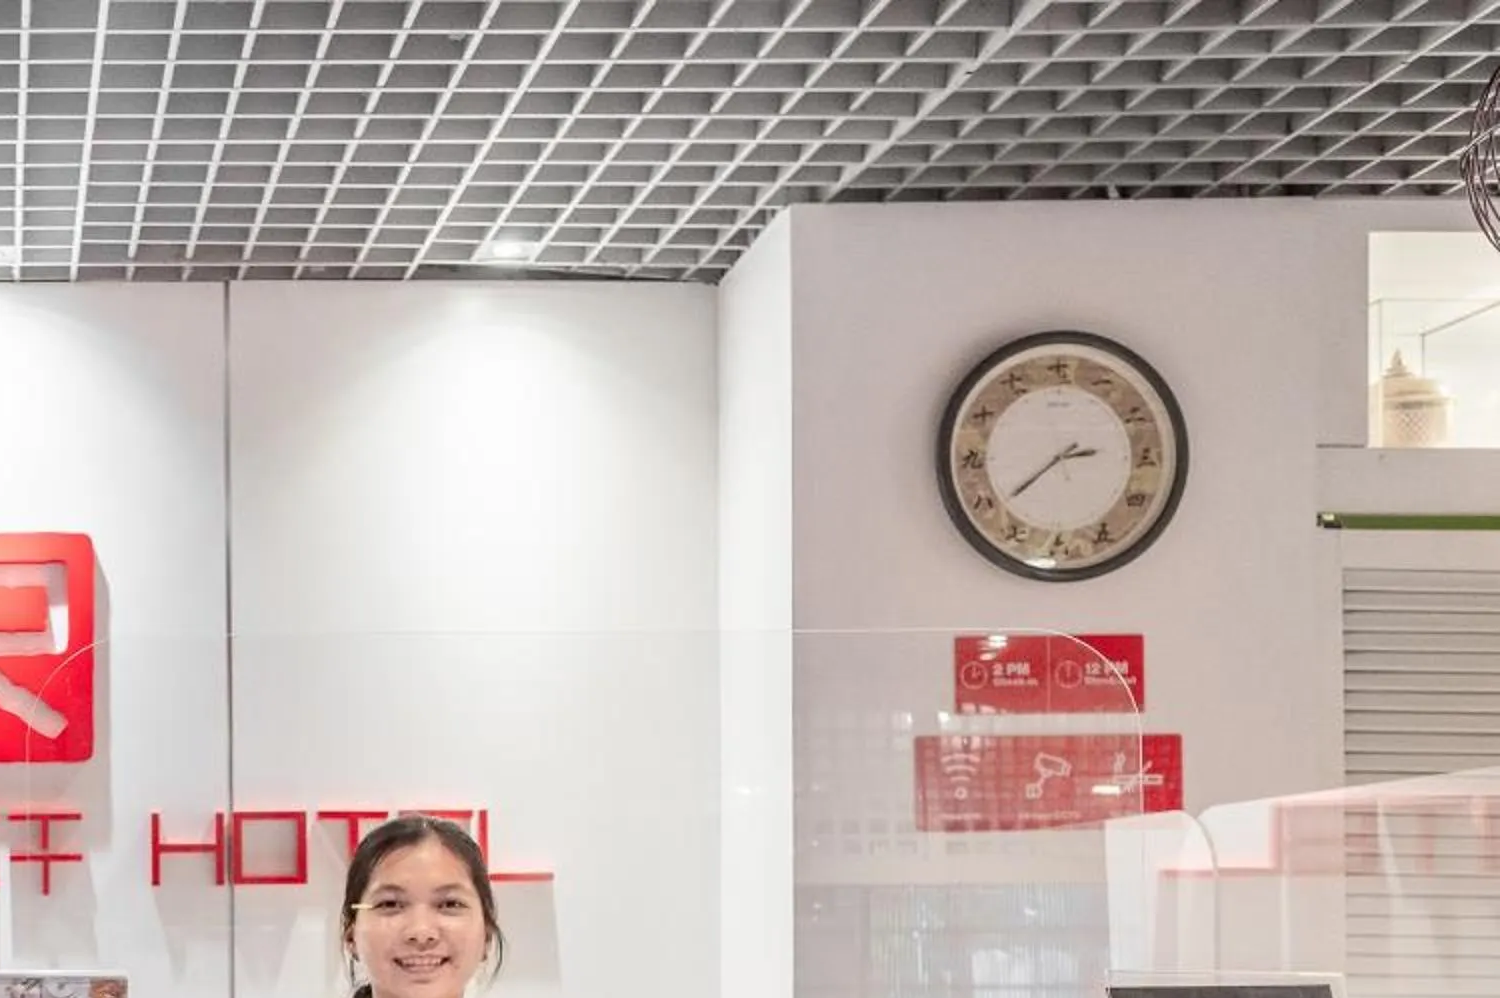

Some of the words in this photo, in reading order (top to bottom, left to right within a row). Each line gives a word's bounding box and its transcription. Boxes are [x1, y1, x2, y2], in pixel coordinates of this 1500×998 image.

[992, 663, 1003, 675] 2
[1006, 662, 1030, 676] PM
[1085, 662, 1102, 675] 12
[151, 810, 554, 885] HOTL
